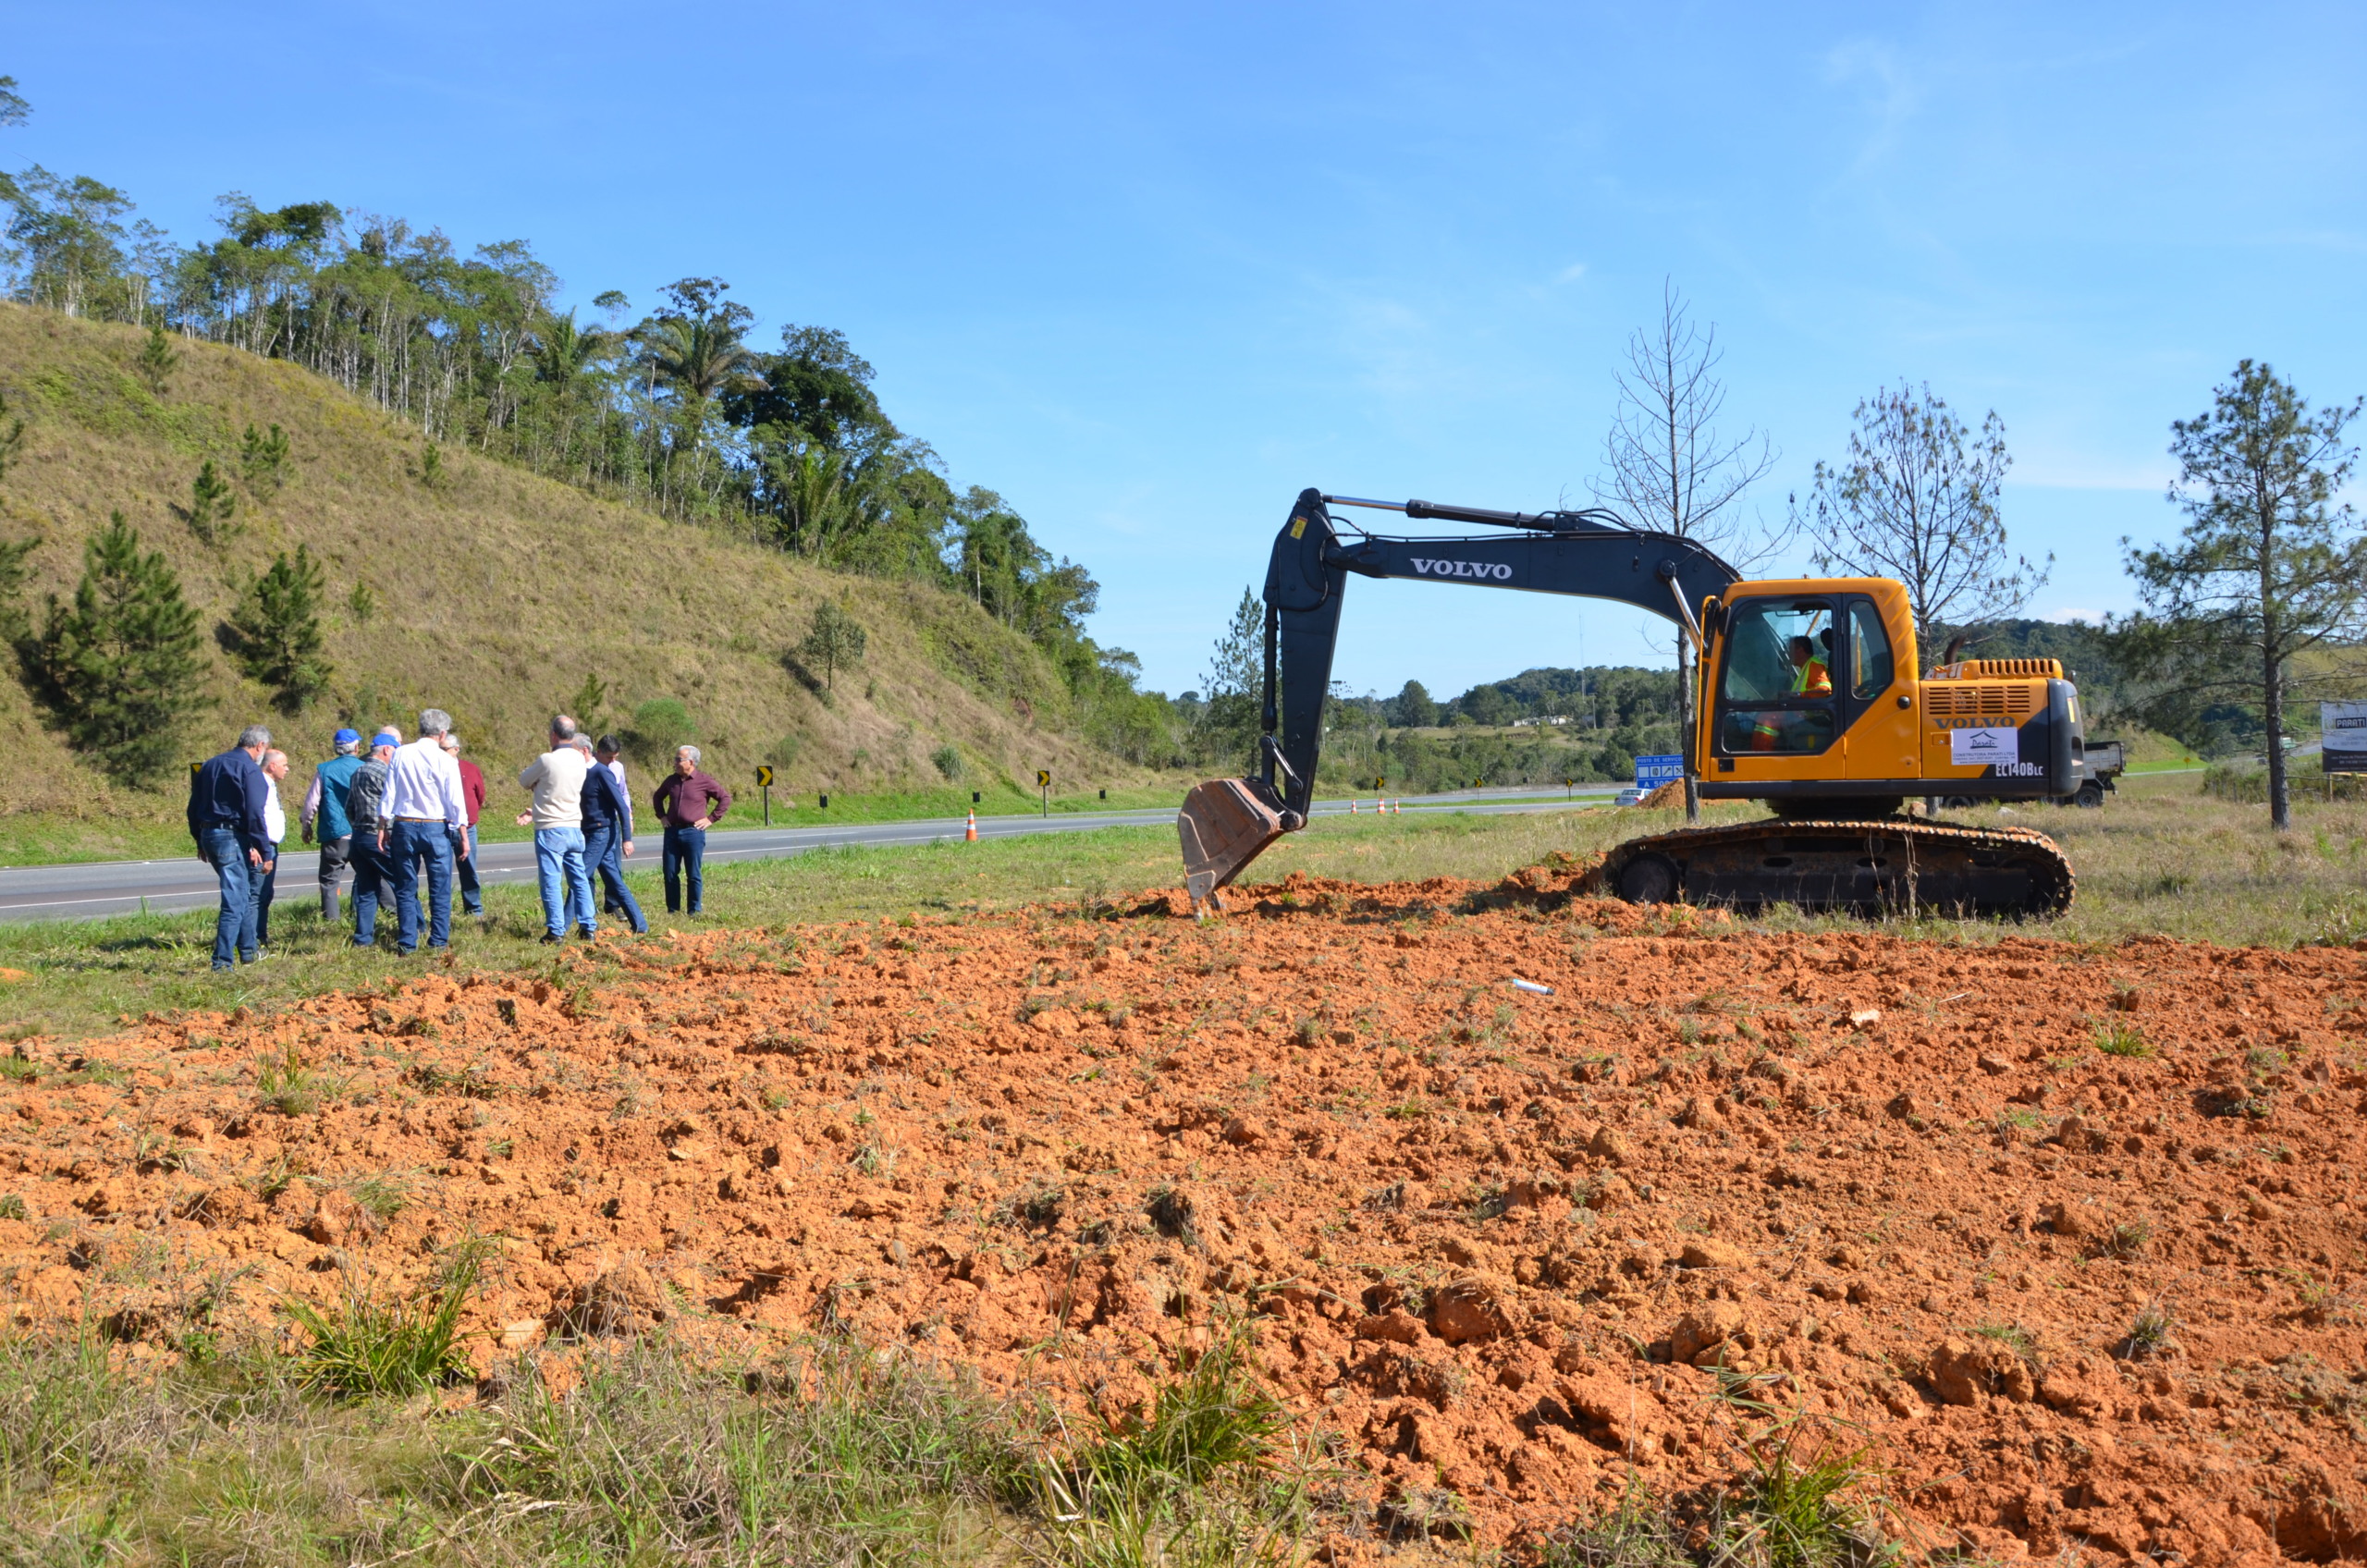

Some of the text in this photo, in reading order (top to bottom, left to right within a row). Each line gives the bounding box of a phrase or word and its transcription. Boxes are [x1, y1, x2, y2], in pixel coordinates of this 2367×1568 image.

[1410, 557, 1513, 579] VOLVO
[1934, 717, 2015, 729] VOLVO
[2336, 718, 2366, 728] PARATI
